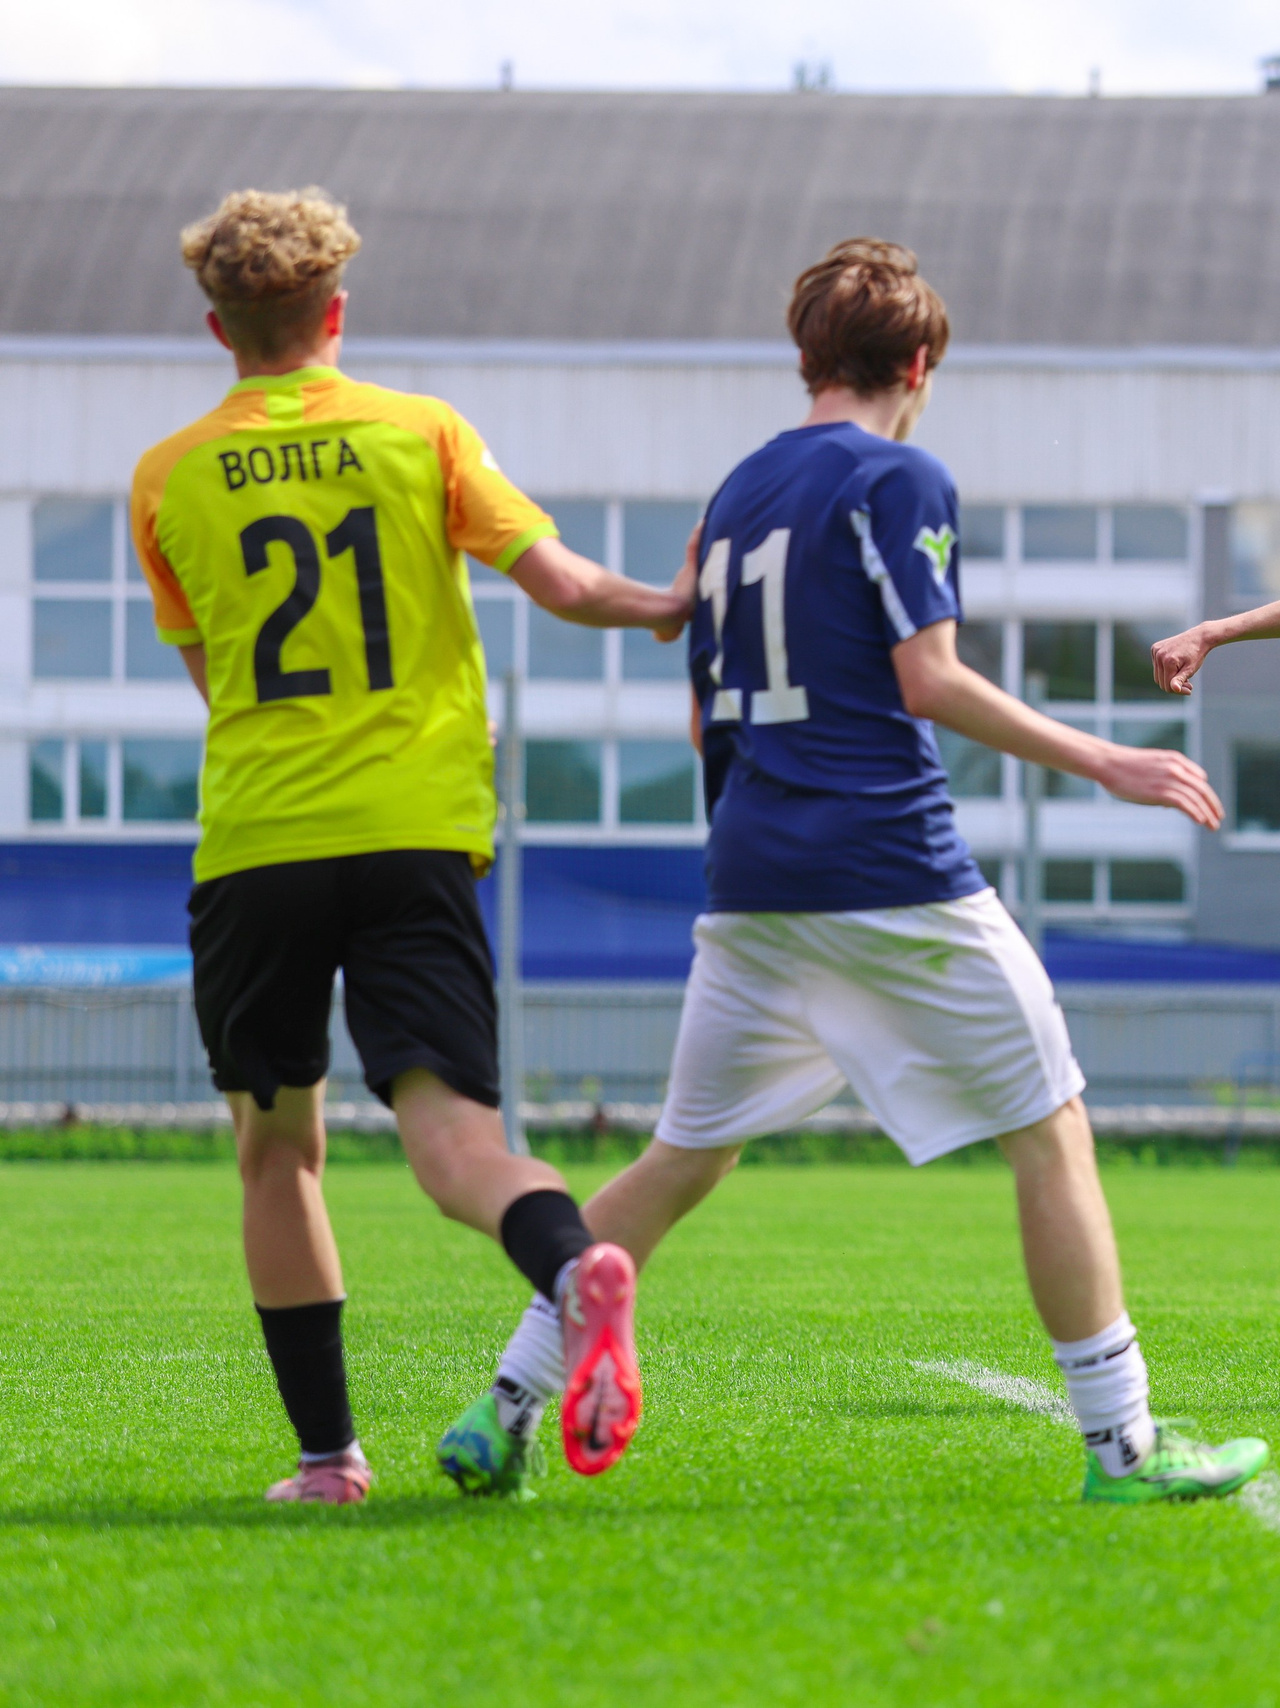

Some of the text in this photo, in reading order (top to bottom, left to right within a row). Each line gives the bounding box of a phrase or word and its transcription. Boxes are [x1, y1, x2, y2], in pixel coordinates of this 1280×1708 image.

[219, 438, 363, 491] ВОЛГА
[239, 505, 395, 704] 21
[699, 527, 810, 725] 11
